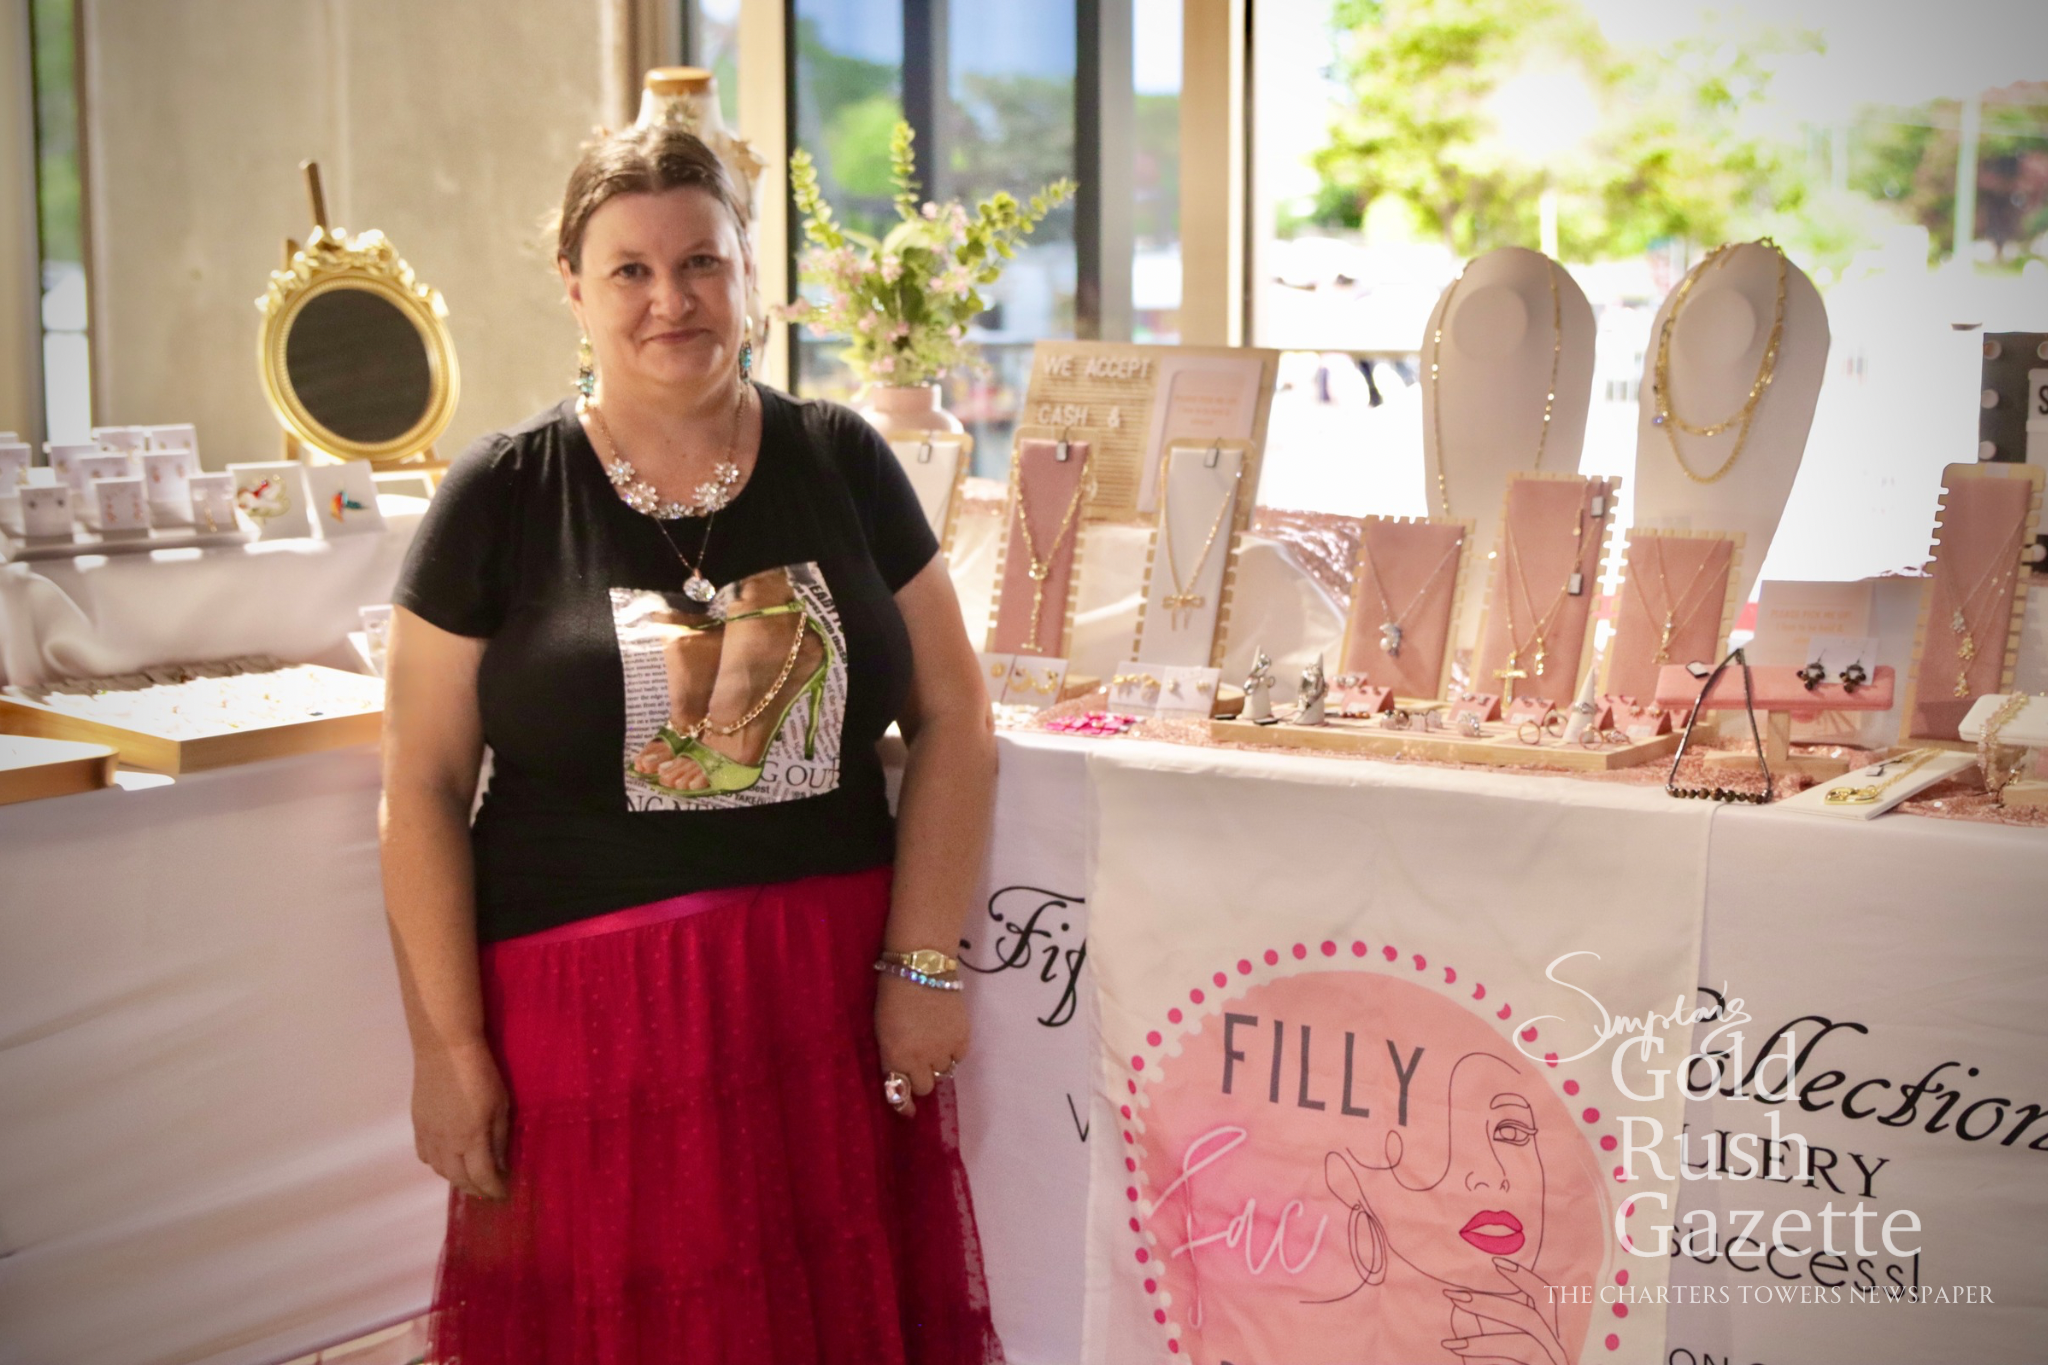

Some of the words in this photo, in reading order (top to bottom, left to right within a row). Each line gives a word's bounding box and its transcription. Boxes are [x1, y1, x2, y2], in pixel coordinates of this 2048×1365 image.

[1043, 355, 1073, 377] WE
[1084, 357, 1151, 379] ACCEPT
[1038, 404, 1089, 426] CASH
[1106, 406, 1121, 428] &
[809, 581, 838, 615] EADY
[1222, 1012, 1425, 1127] FILLY
[1687, 986, 2048, 1151] ollection
